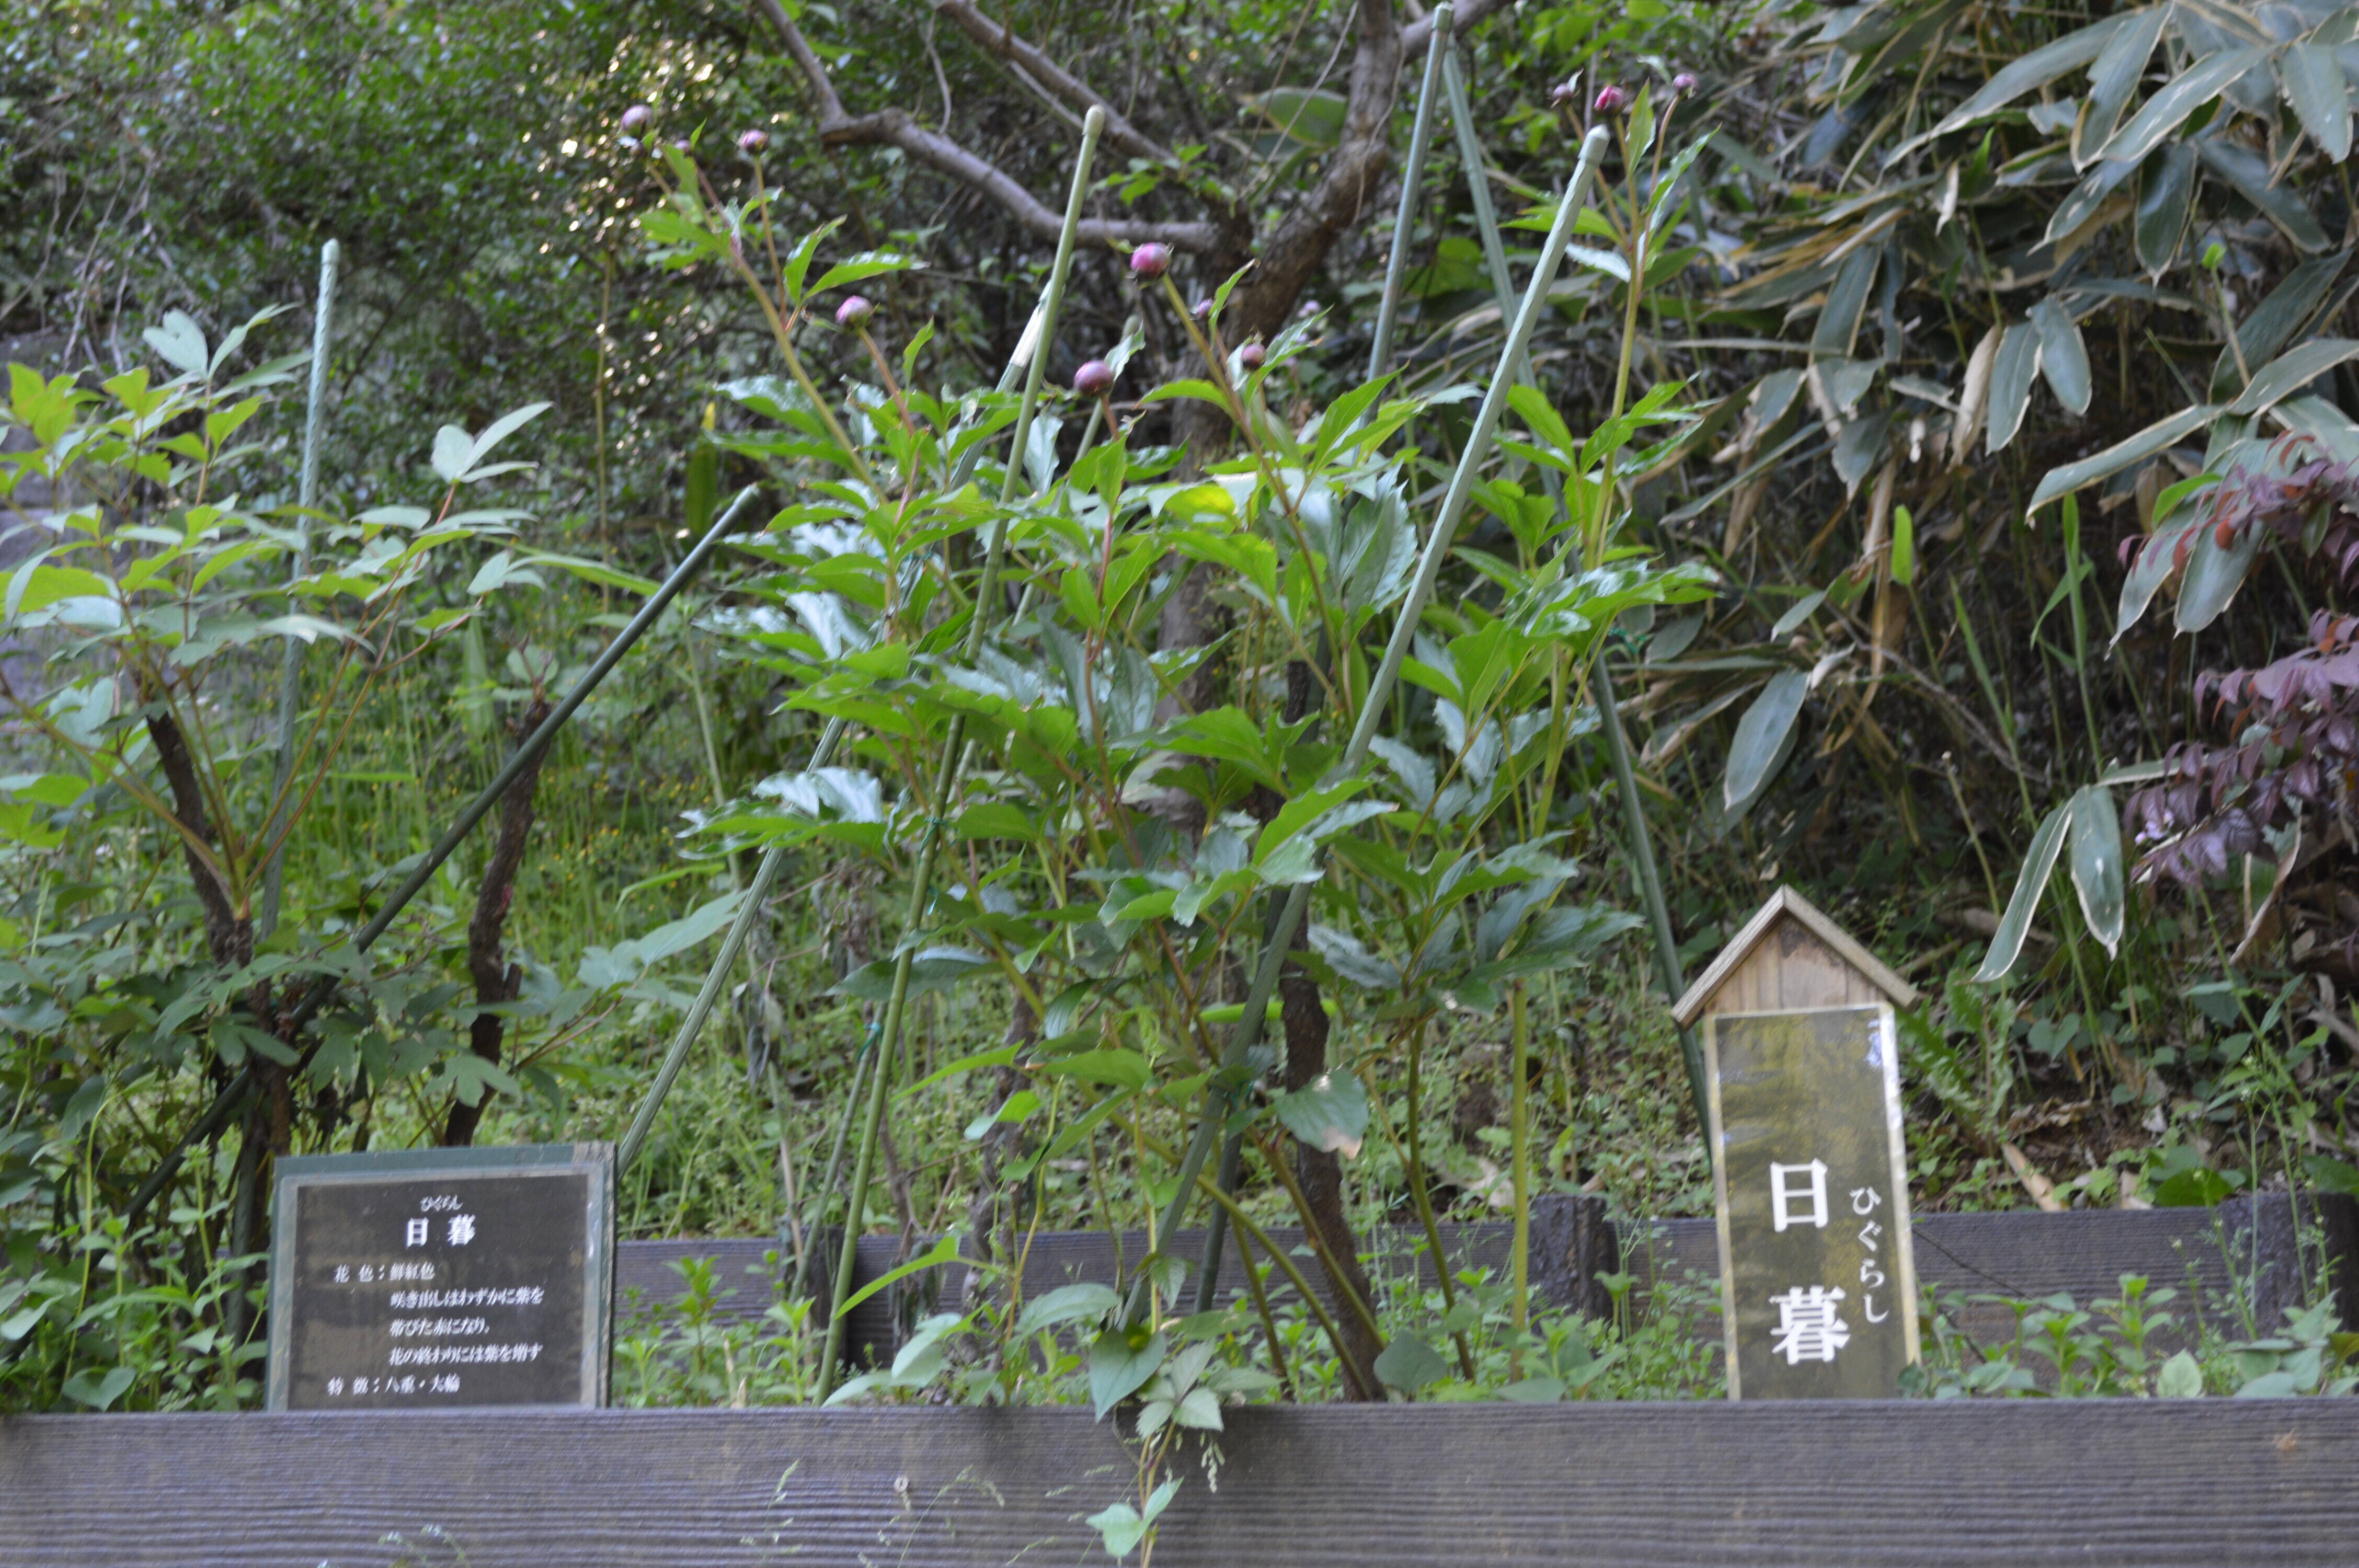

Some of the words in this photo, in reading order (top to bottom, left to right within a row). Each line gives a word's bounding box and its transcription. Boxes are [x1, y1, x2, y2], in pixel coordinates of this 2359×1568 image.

[406, 1214, 476, 1248] 日暮
[420, 1194, 463, 1213] ひぐらし
[1769, 1157, 1852, 1367] 日暮
[1848, 1186, 1890, 1325] ひぐらし
